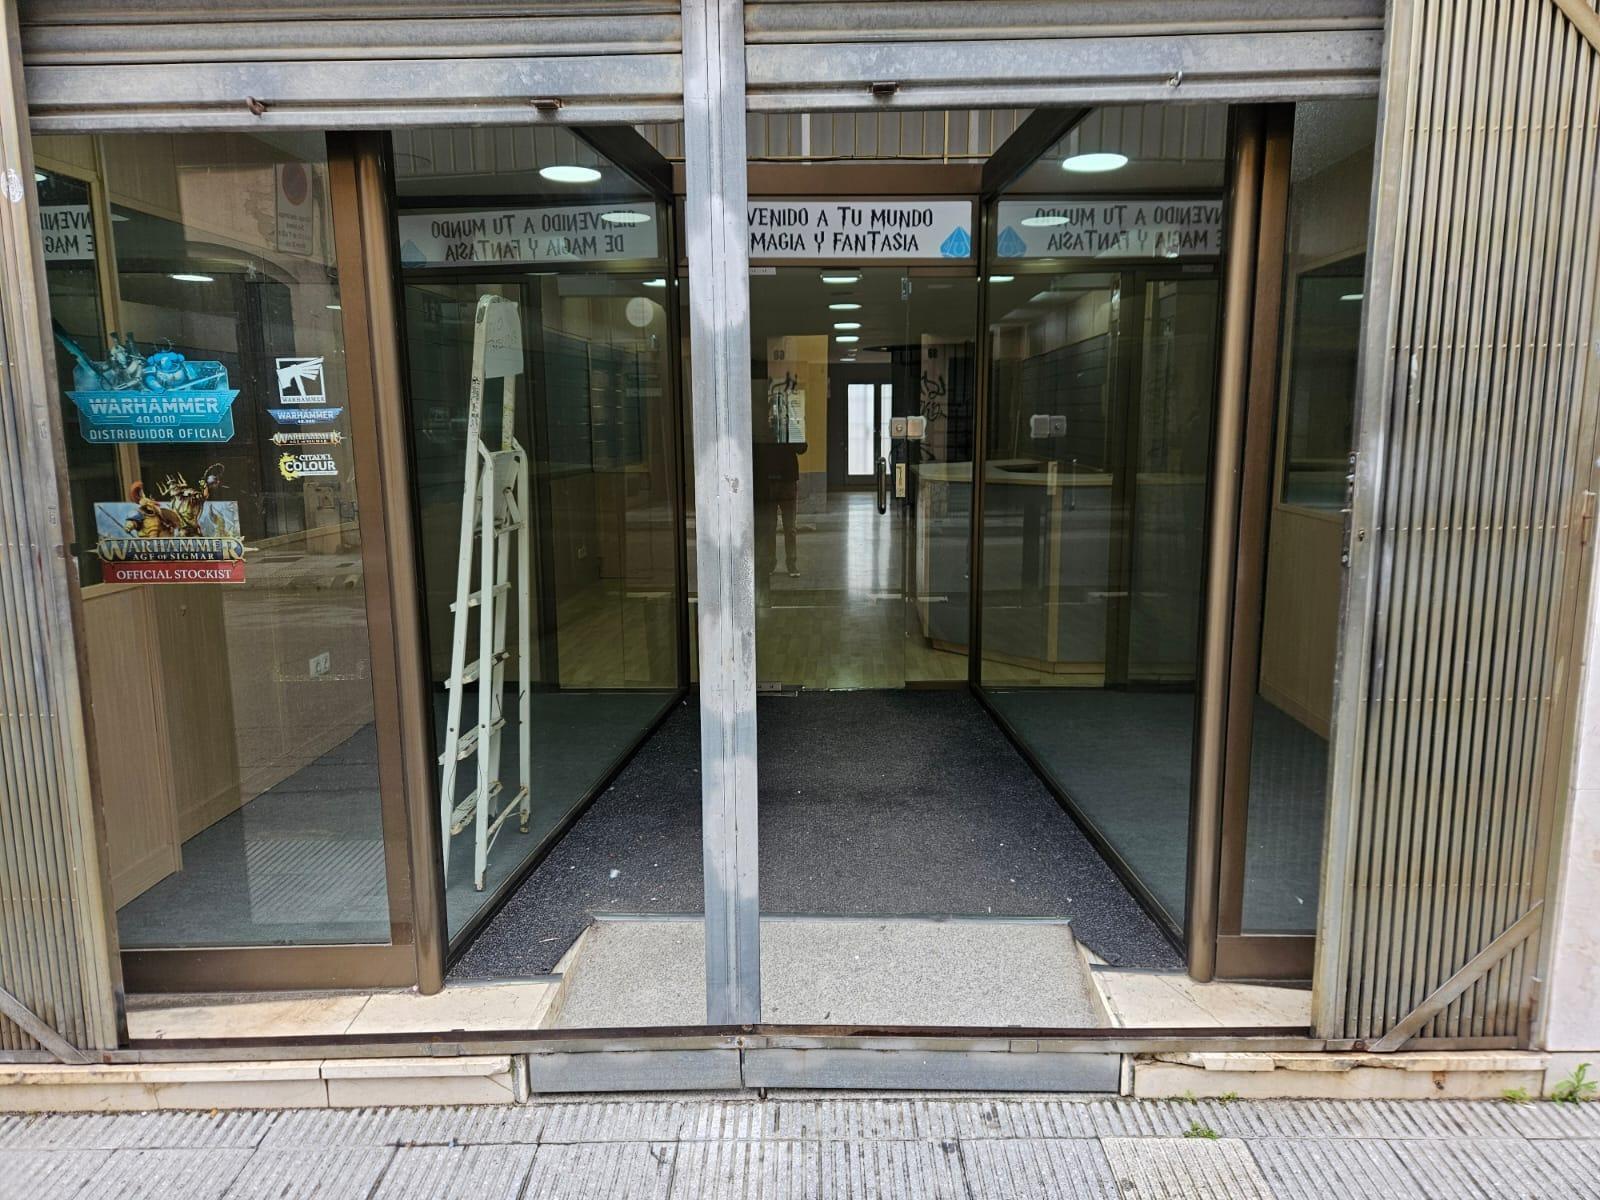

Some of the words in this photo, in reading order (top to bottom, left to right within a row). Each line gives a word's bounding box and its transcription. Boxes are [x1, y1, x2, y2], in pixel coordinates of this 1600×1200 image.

[817, 209, 828, 227] A
[837, 206, 862, 229] TU
[870, 208, 933, 230] MUNDO
[750, 232, 806, 253] MAGIA
[814, 231, 825, 254] Y
[832, 230, 919, 255] FANTASIA
[89, 398, 220, 415] WARHAMMER
[135, 415, 176, 425] 40.000
[277, 411, 334, 420] WARHAMMER
[89, 428, 174, 440] DISTRIBUIDOR
[178, 428, 227, 440] OFICIAL
[285, 461, 336, 471] COLOUR
[98, 537, 246, 561] WARHAMMER
[132, 553, 155, 561] AGE
[170, 552, 215, 560] SIGMAR
[116, 569, 173, 580] OFFICIAL
[174, 568, 232, 579] STOCKIST
